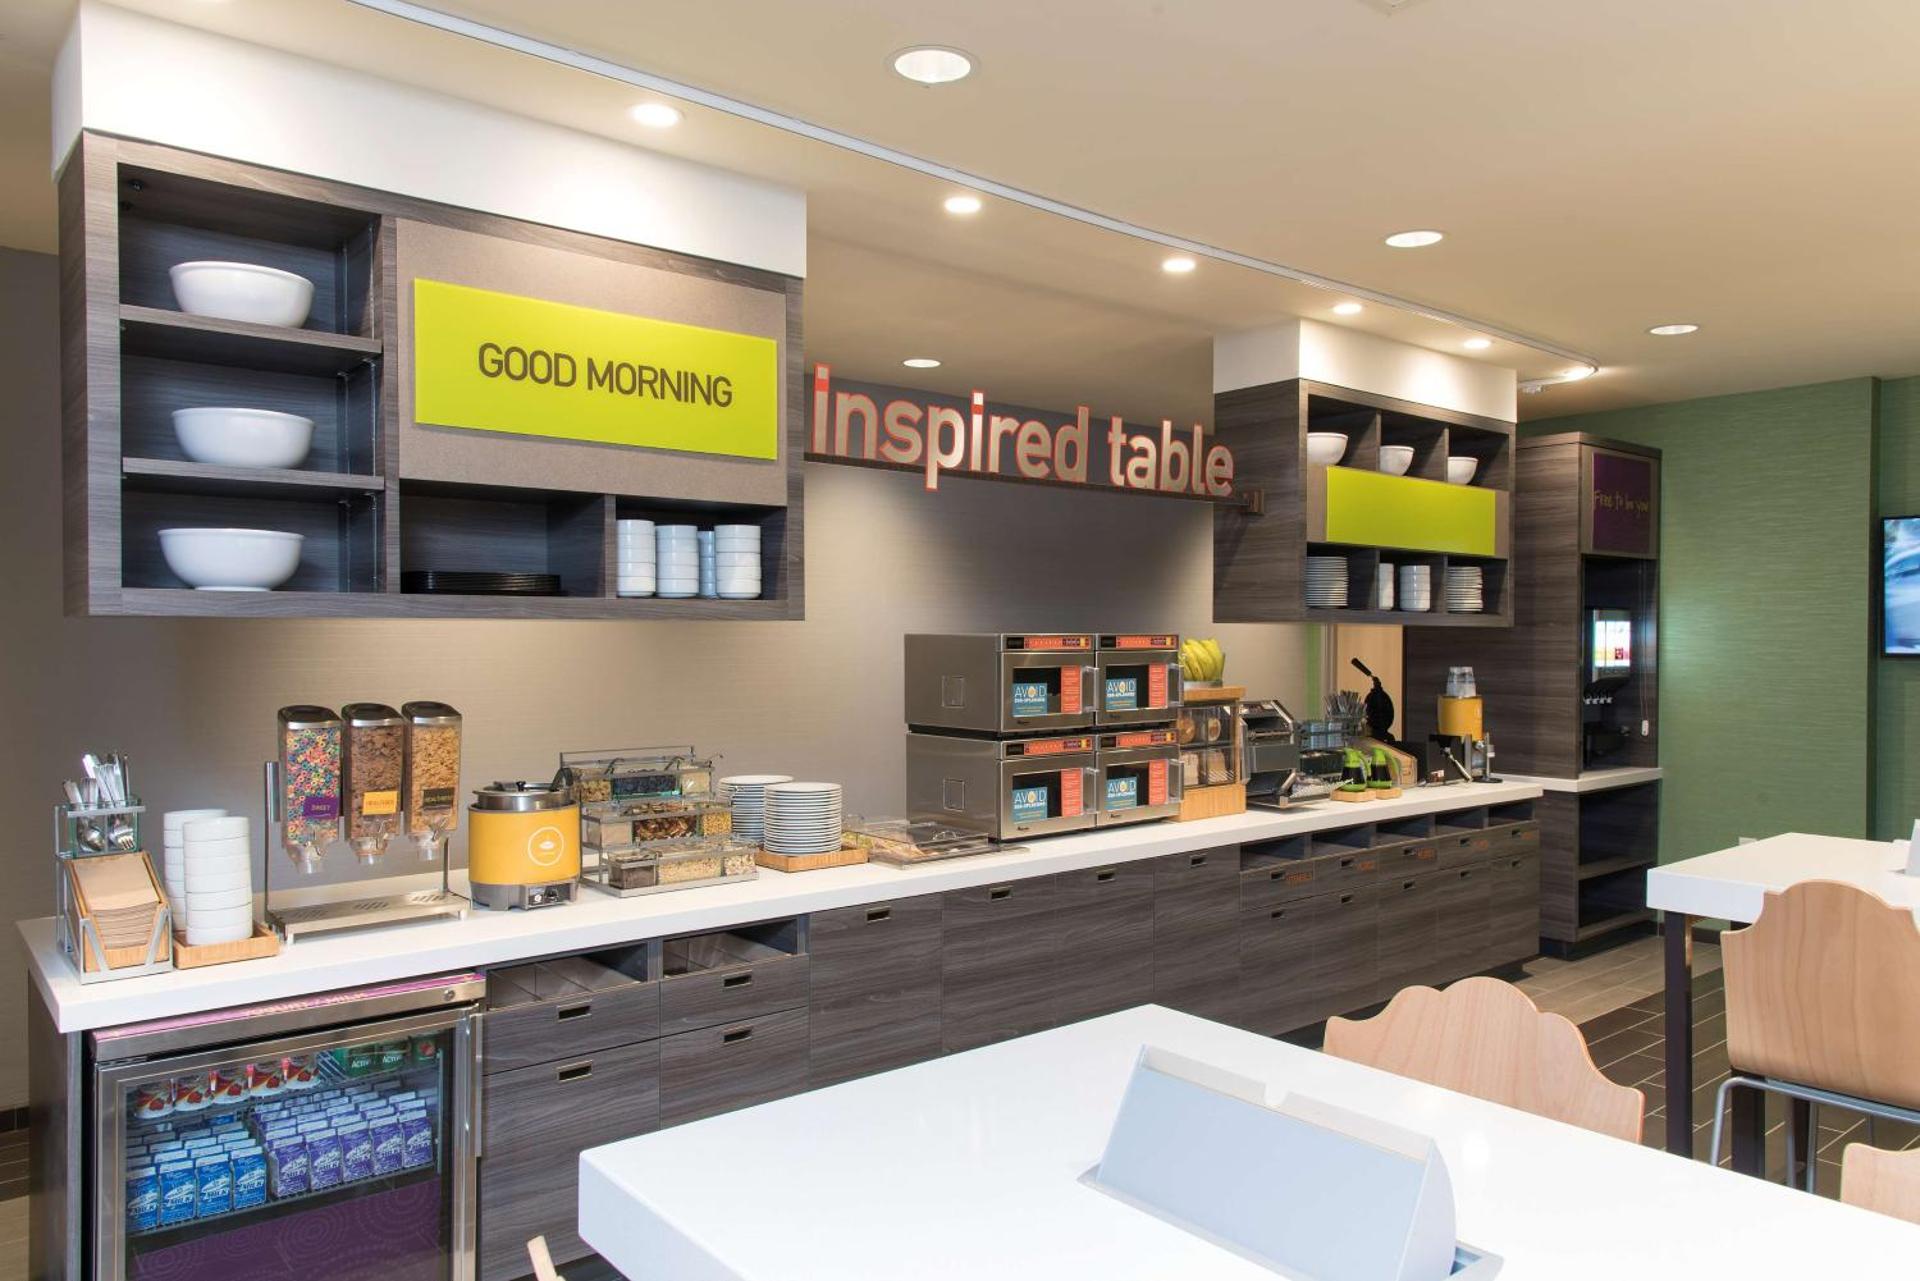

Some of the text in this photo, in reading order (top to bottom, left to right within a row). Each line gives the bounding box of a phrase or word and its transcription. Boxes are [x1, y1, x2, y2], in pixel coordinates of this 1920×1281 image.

[477, 342, 733, 408] GOOD MORNING
[811, 362, 1235, 497] inspired table
[1014, 685, 1047, 698] AVOID
[1106, 680, 1136, 693] AVOID
[1107, 780, 1137, 793] AVOID
[1014, 790, 1047, 803] AVOID
